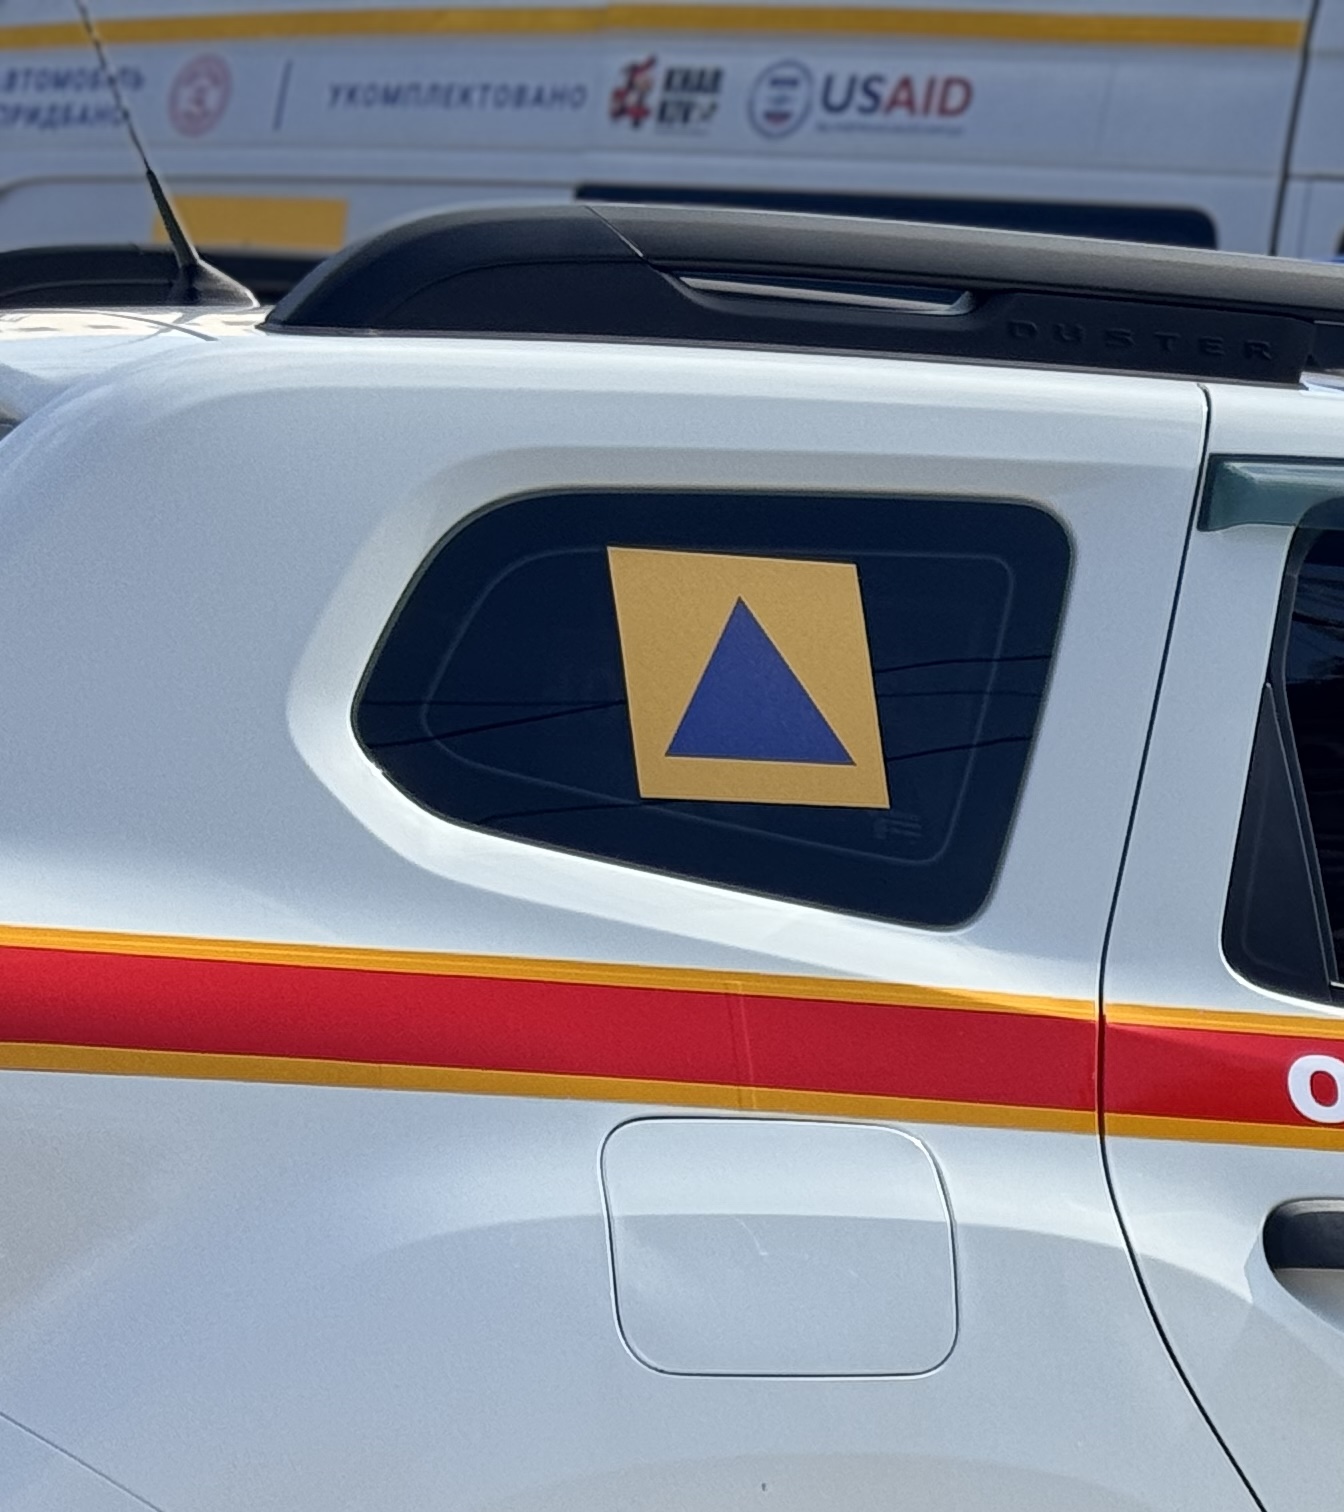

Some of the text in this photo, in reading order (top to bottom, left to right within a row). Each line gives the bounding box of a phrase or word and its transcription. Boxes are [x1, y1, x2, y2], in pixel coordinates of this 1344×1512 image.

[328, 81, 589, 110] УКОМПЛЕКТОВАНО
[820, 72, 974, 118] USAID
[1007, 319, 1273, 362] DUSTER
